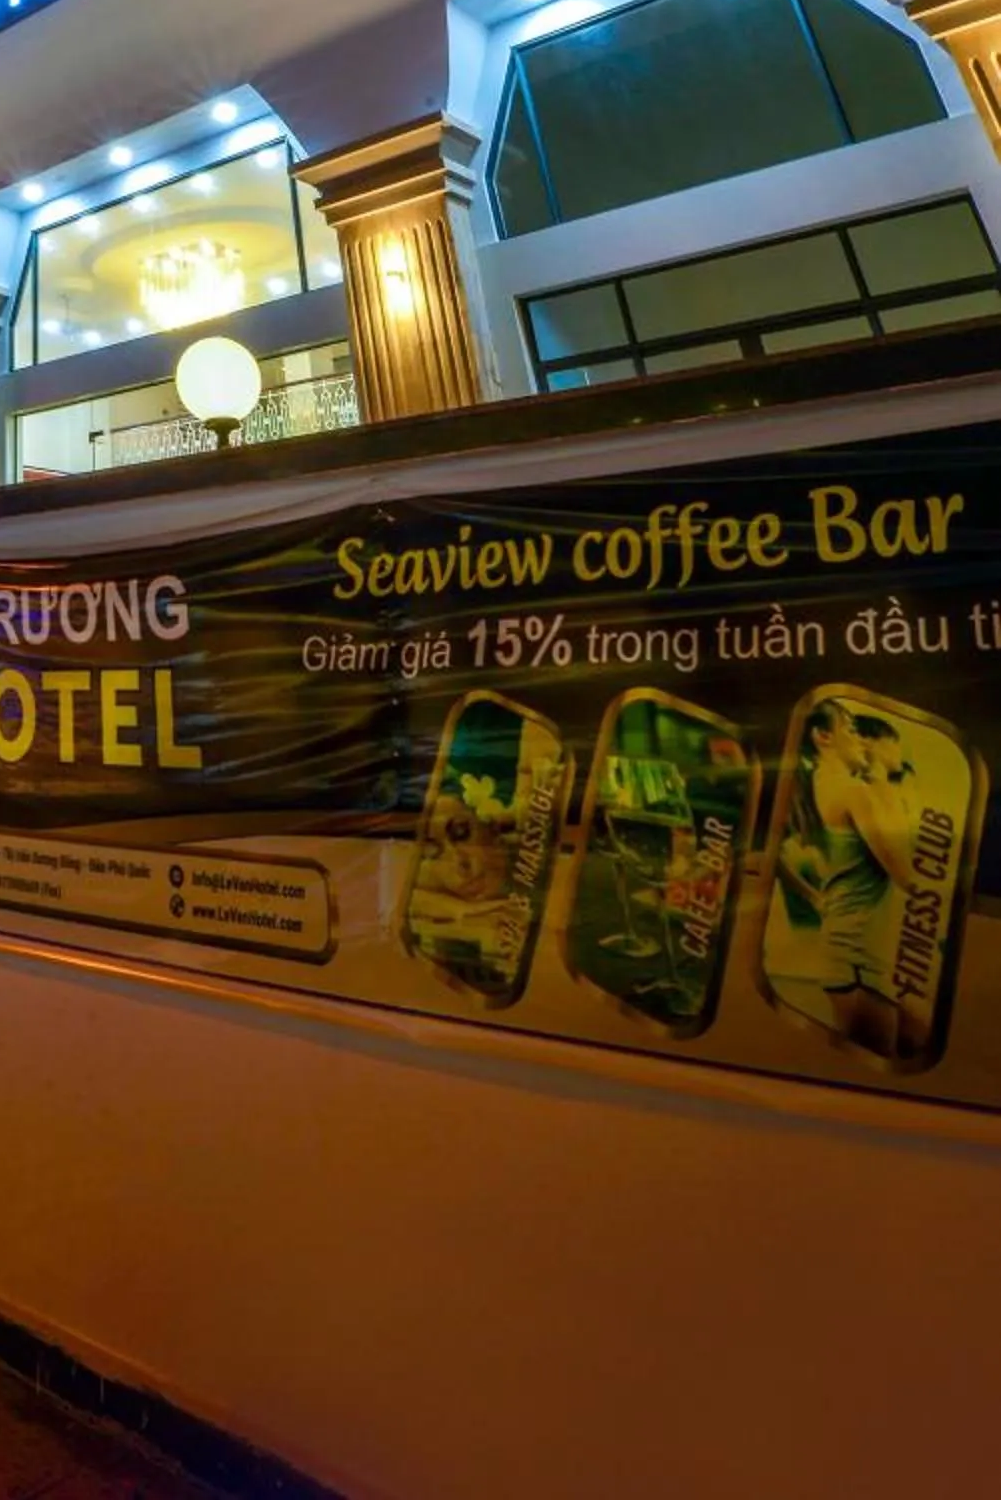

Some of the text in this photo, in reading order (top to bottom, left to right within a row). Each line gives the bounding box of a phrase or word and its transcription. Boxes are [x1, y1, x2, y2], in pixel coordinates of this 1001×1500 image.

[333, 485, 964, 599] Seaview coffee Bar
[302, 632, 390, 672] Giảm
[400, 630, 452, 680] giá
[467, 614, 573, 667] 15%
[587, 624, 698, 673] trong
[716, 602, 826, 660] tuần
[845, 596, 949, 655] đầu
[512, 782, 557, 889] MASSAGE
[701, 815, 734, 873] BAR
[892, 806, 955, 999] FITNESS CLUB
